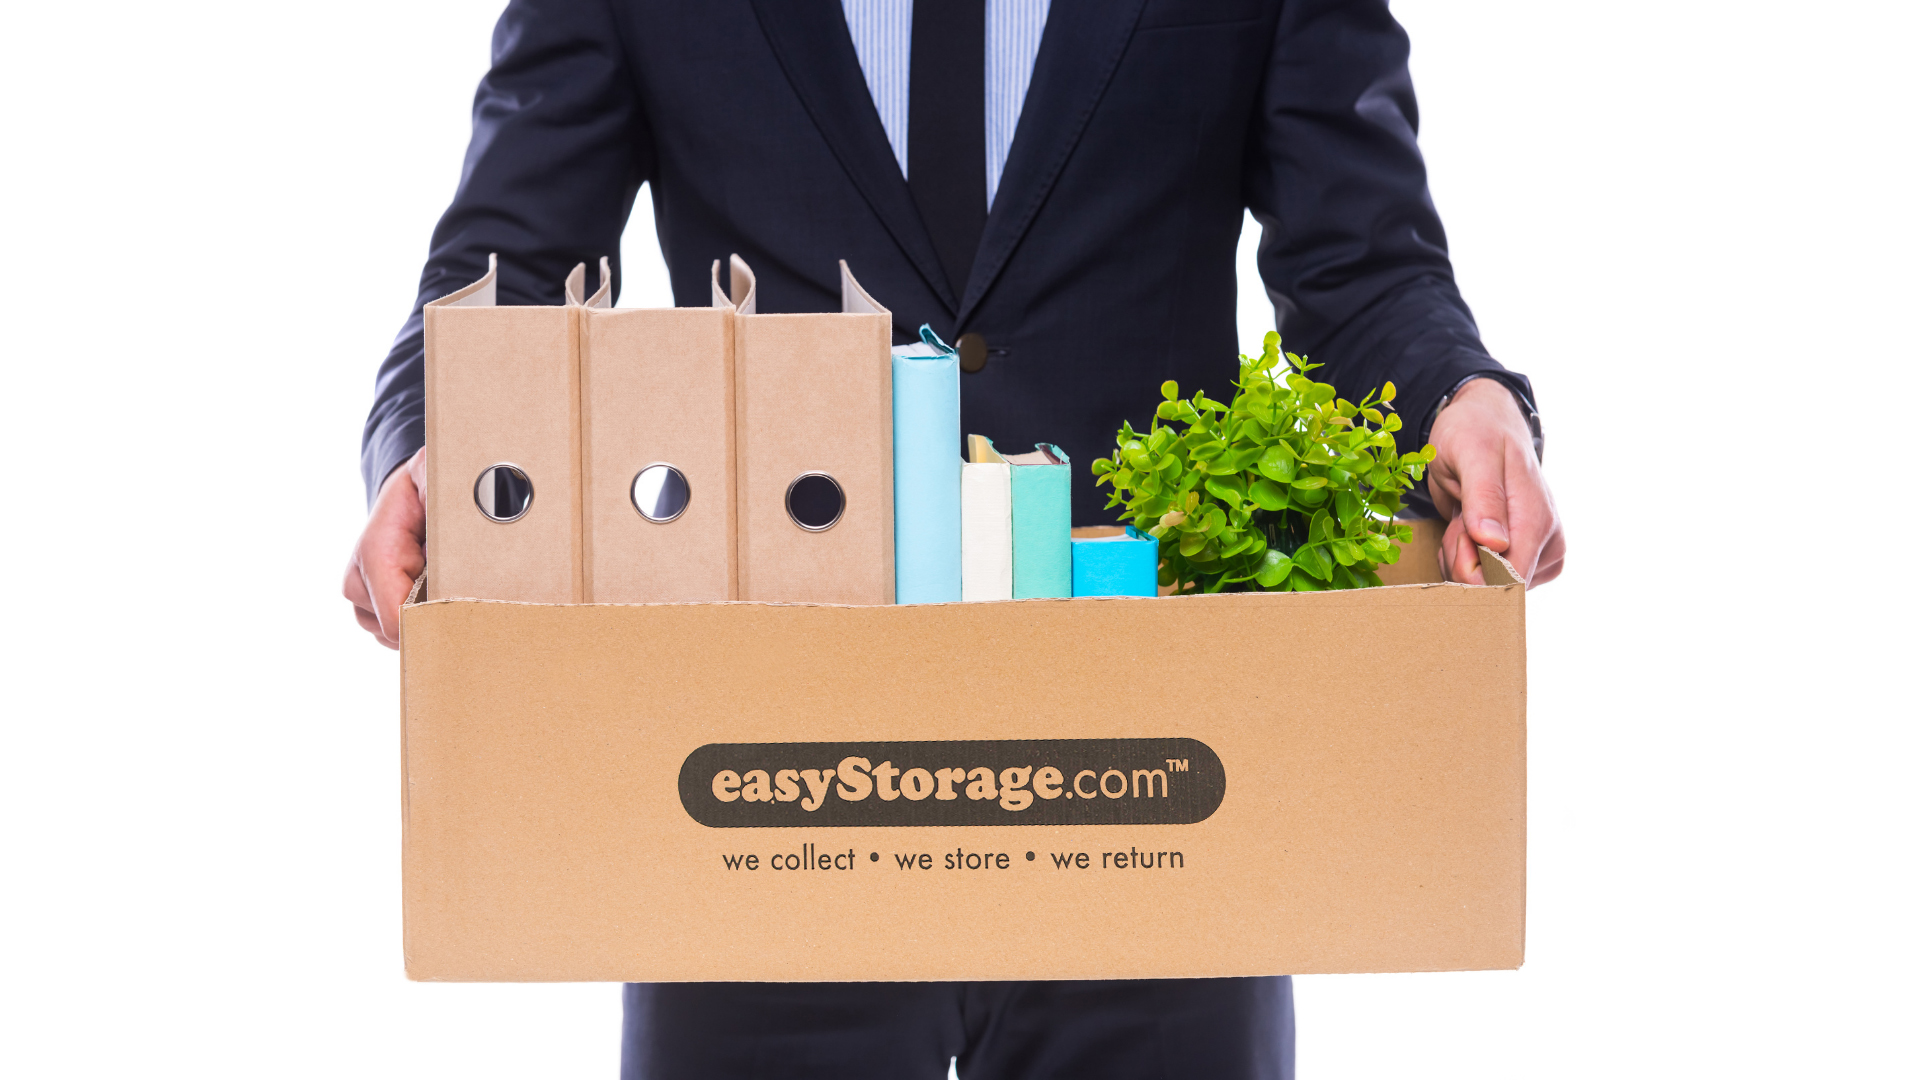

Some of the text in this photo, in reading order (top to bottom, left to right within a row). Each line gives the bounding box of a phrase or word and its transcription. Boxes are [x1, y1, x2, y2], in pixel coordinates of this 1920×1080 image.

[722, 842, 1184, 870] we collect we store we return
